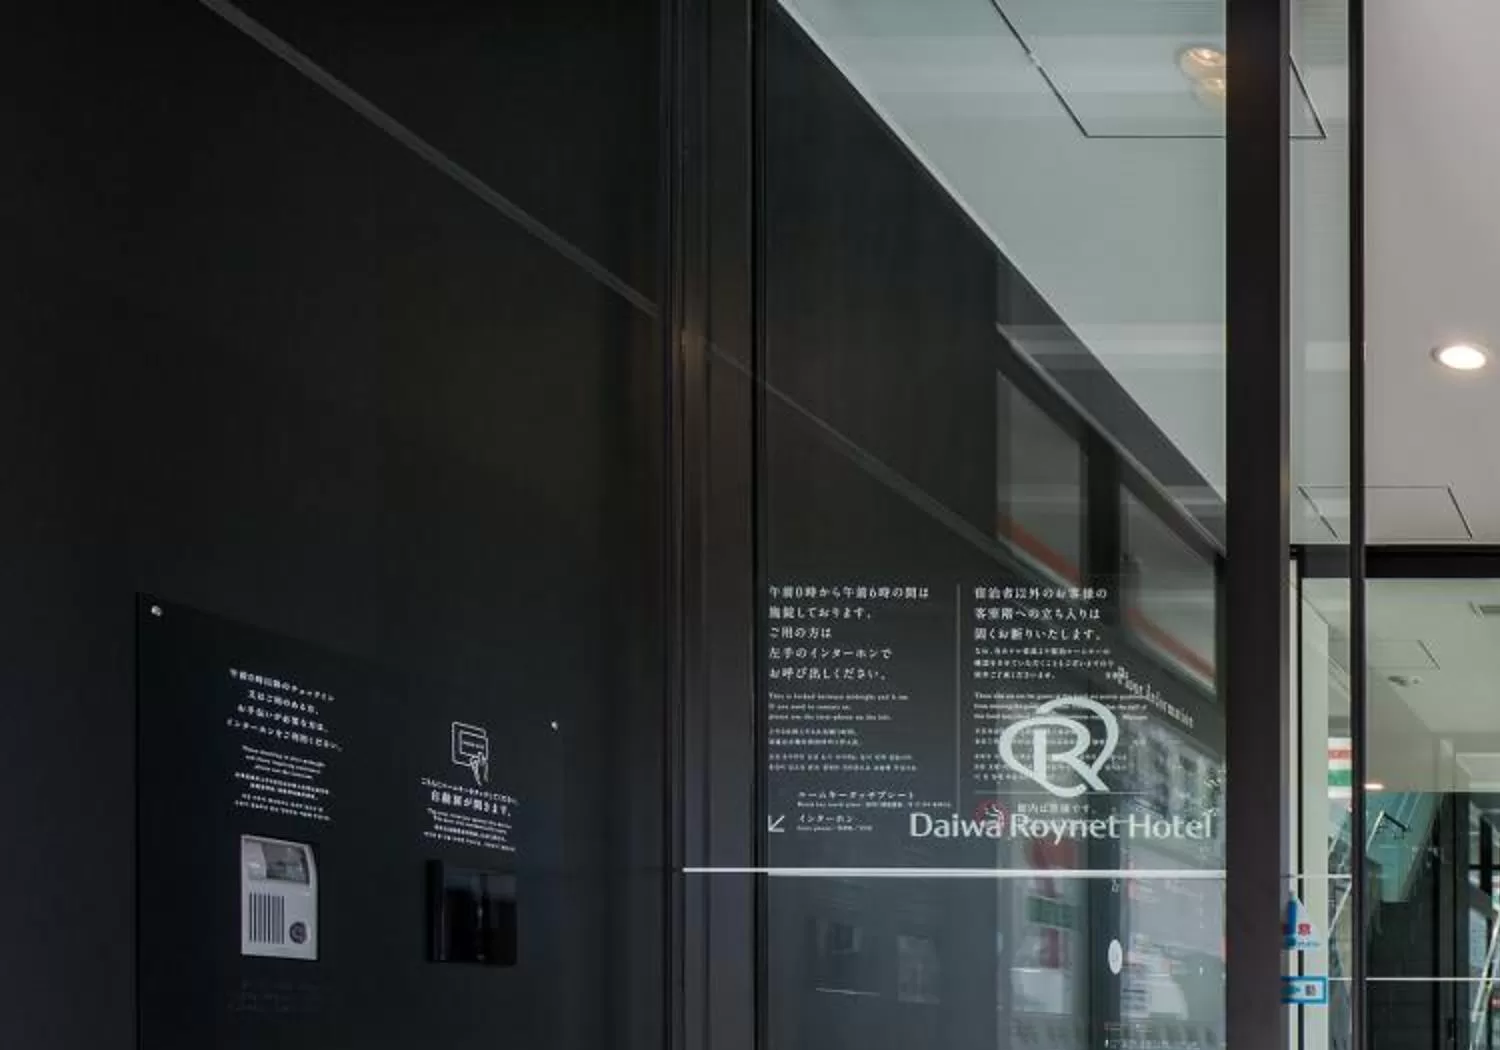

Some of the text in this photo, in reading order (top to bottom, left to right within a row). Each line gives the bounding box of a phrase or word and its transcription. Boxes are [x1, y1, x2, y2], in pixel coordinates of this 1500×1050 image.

[975, 587, 1107, 600] 宿泊者以外のお客様の
[974, 607, 1101, 621] 客室階への立ち入りは
[768, 647, 893, 660] 左手のインターホンで
[909, 812, 1212, 845] Daiwa Roynet Hotel
